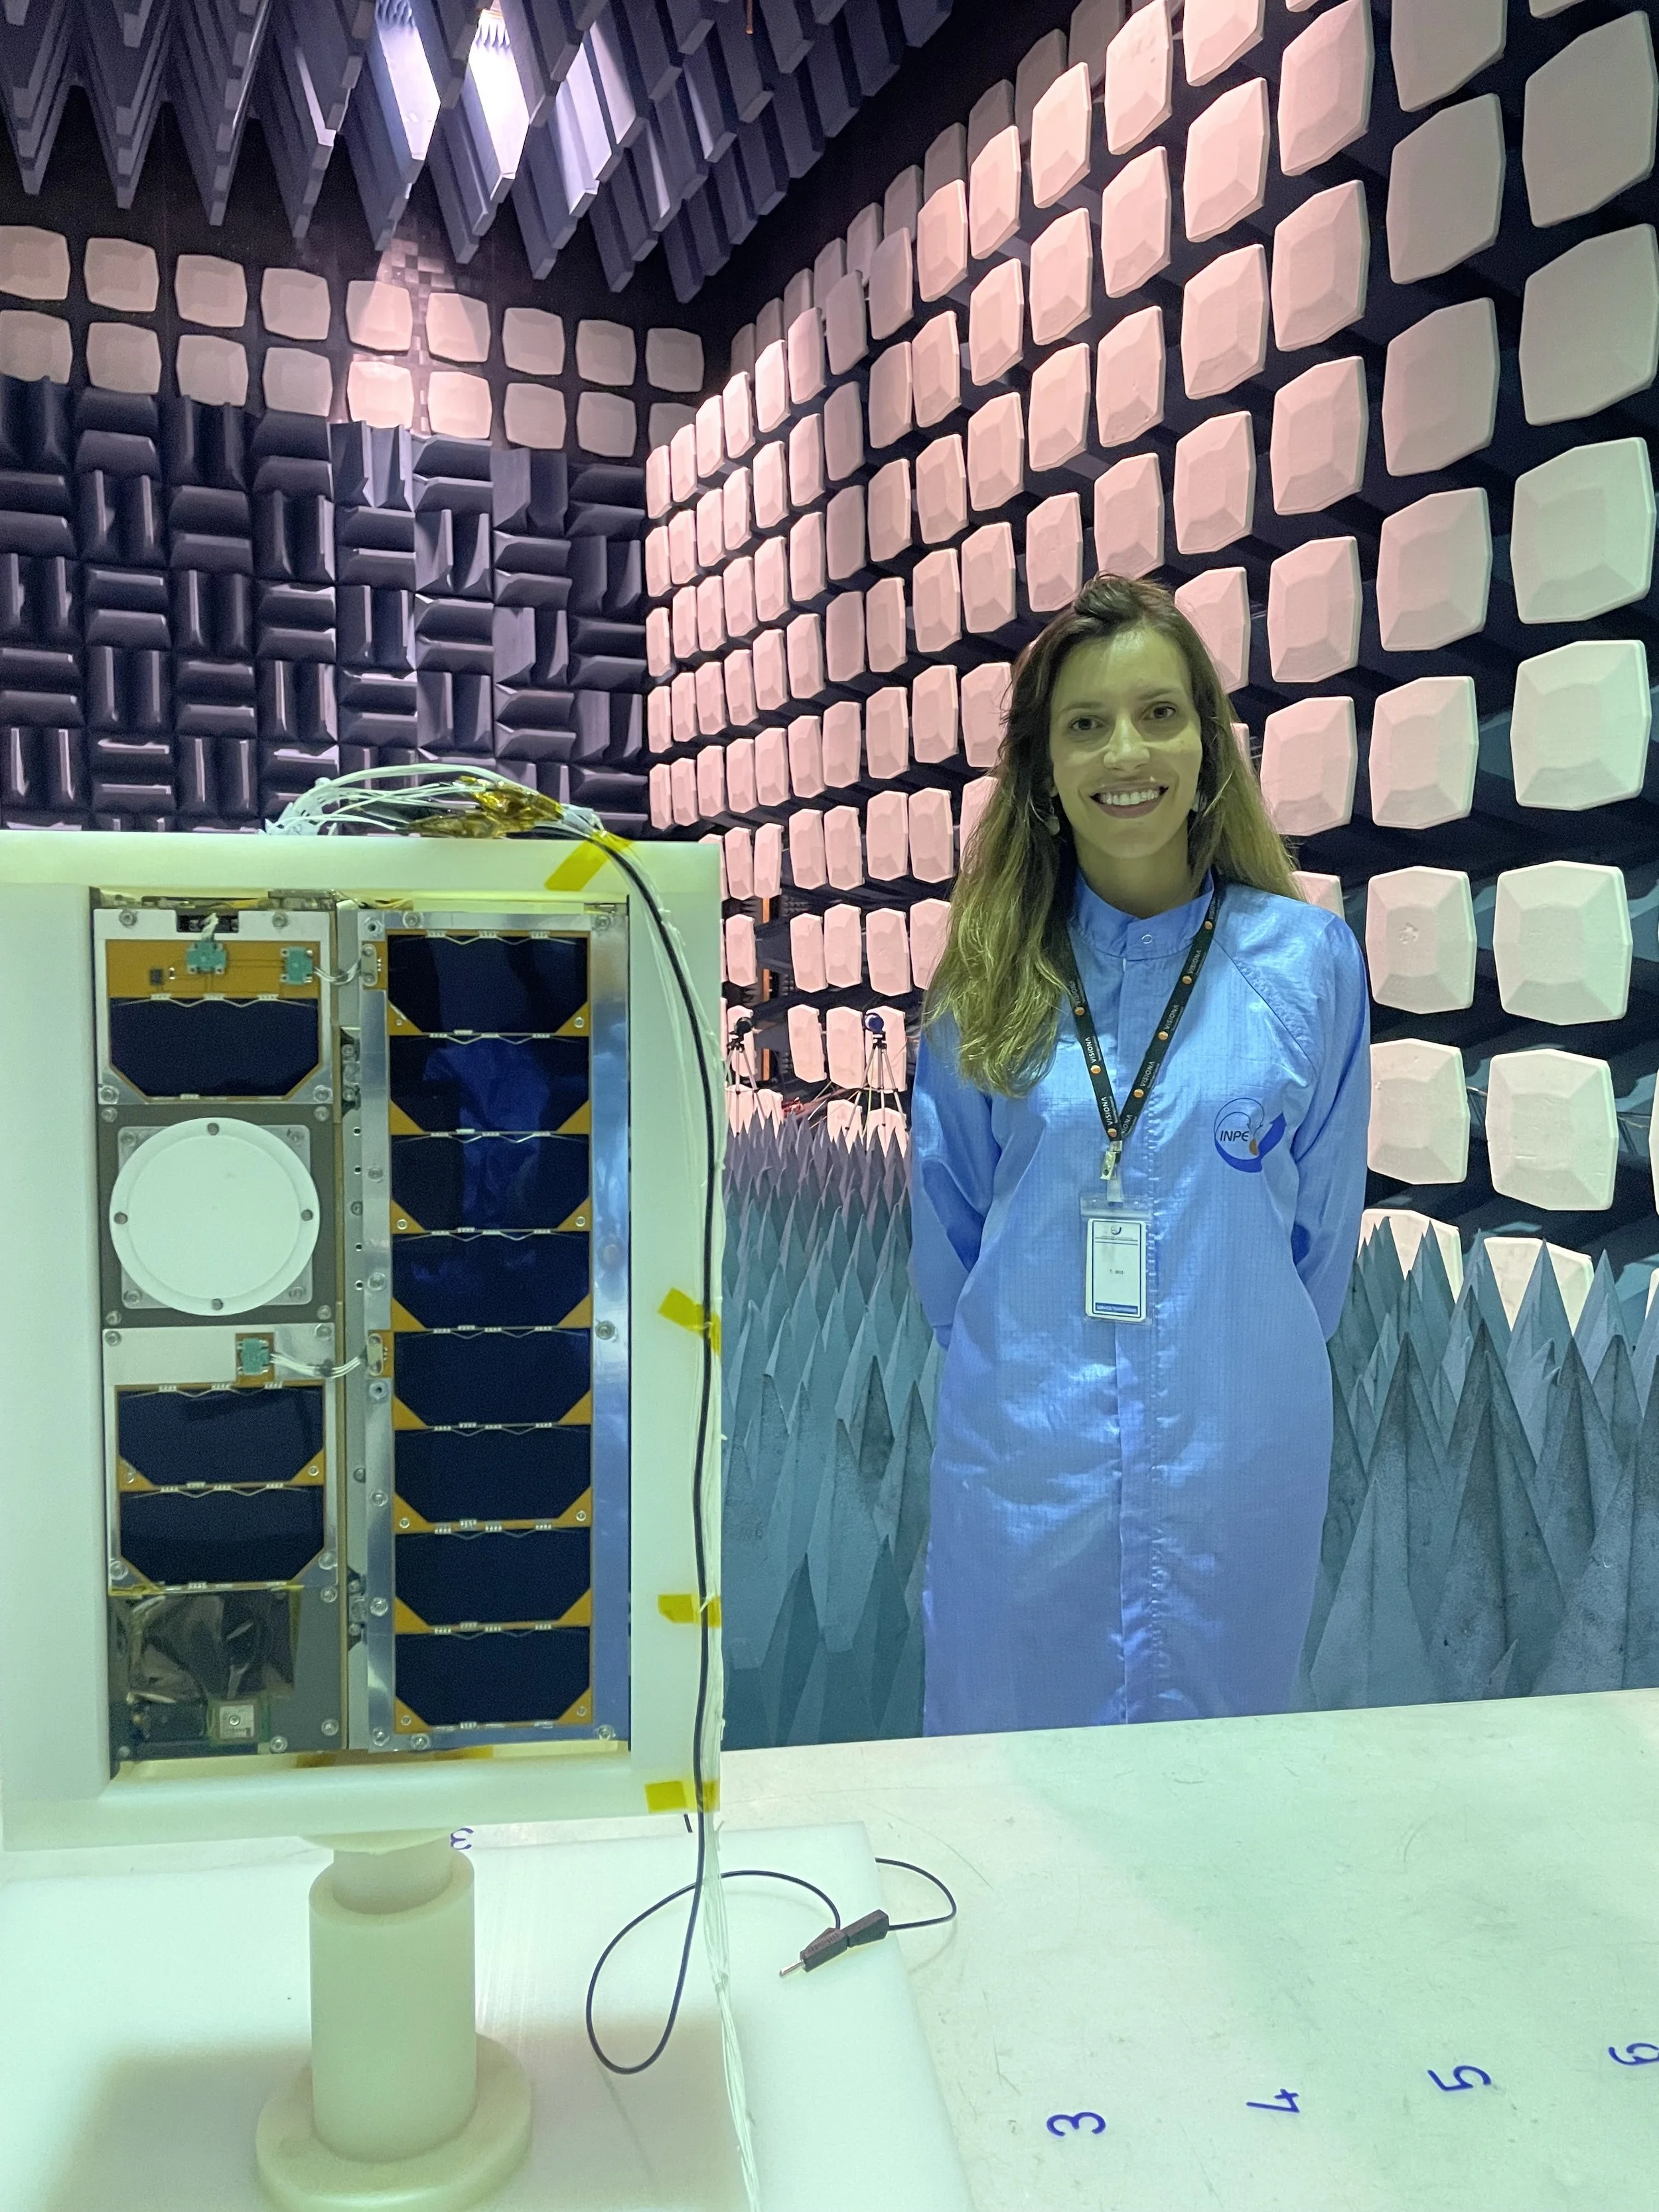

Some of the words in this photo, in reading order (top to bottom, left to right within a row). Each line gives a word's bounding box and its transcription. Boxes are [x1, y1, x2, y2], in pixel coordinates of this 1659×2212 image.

[1189, 950, 1202, 974] VISIONA
[1164, 1004, 1180, 1030] VISIONA
[1085, 1037, 1096, 1063] VISIONA
[1141, 1060, 1155, 1088] VISIONA
[1101, 1097, 1113, 1126] VISIONA
[1220, 1130, 1250, 1142] INPE
[1608, 2043, 1659, 2065] 6
[1427, 2065, 1492, 2091] 5
[1246, 2089, 1300, 2113] 4
[1046, 2112, 1107, 2136] 3
